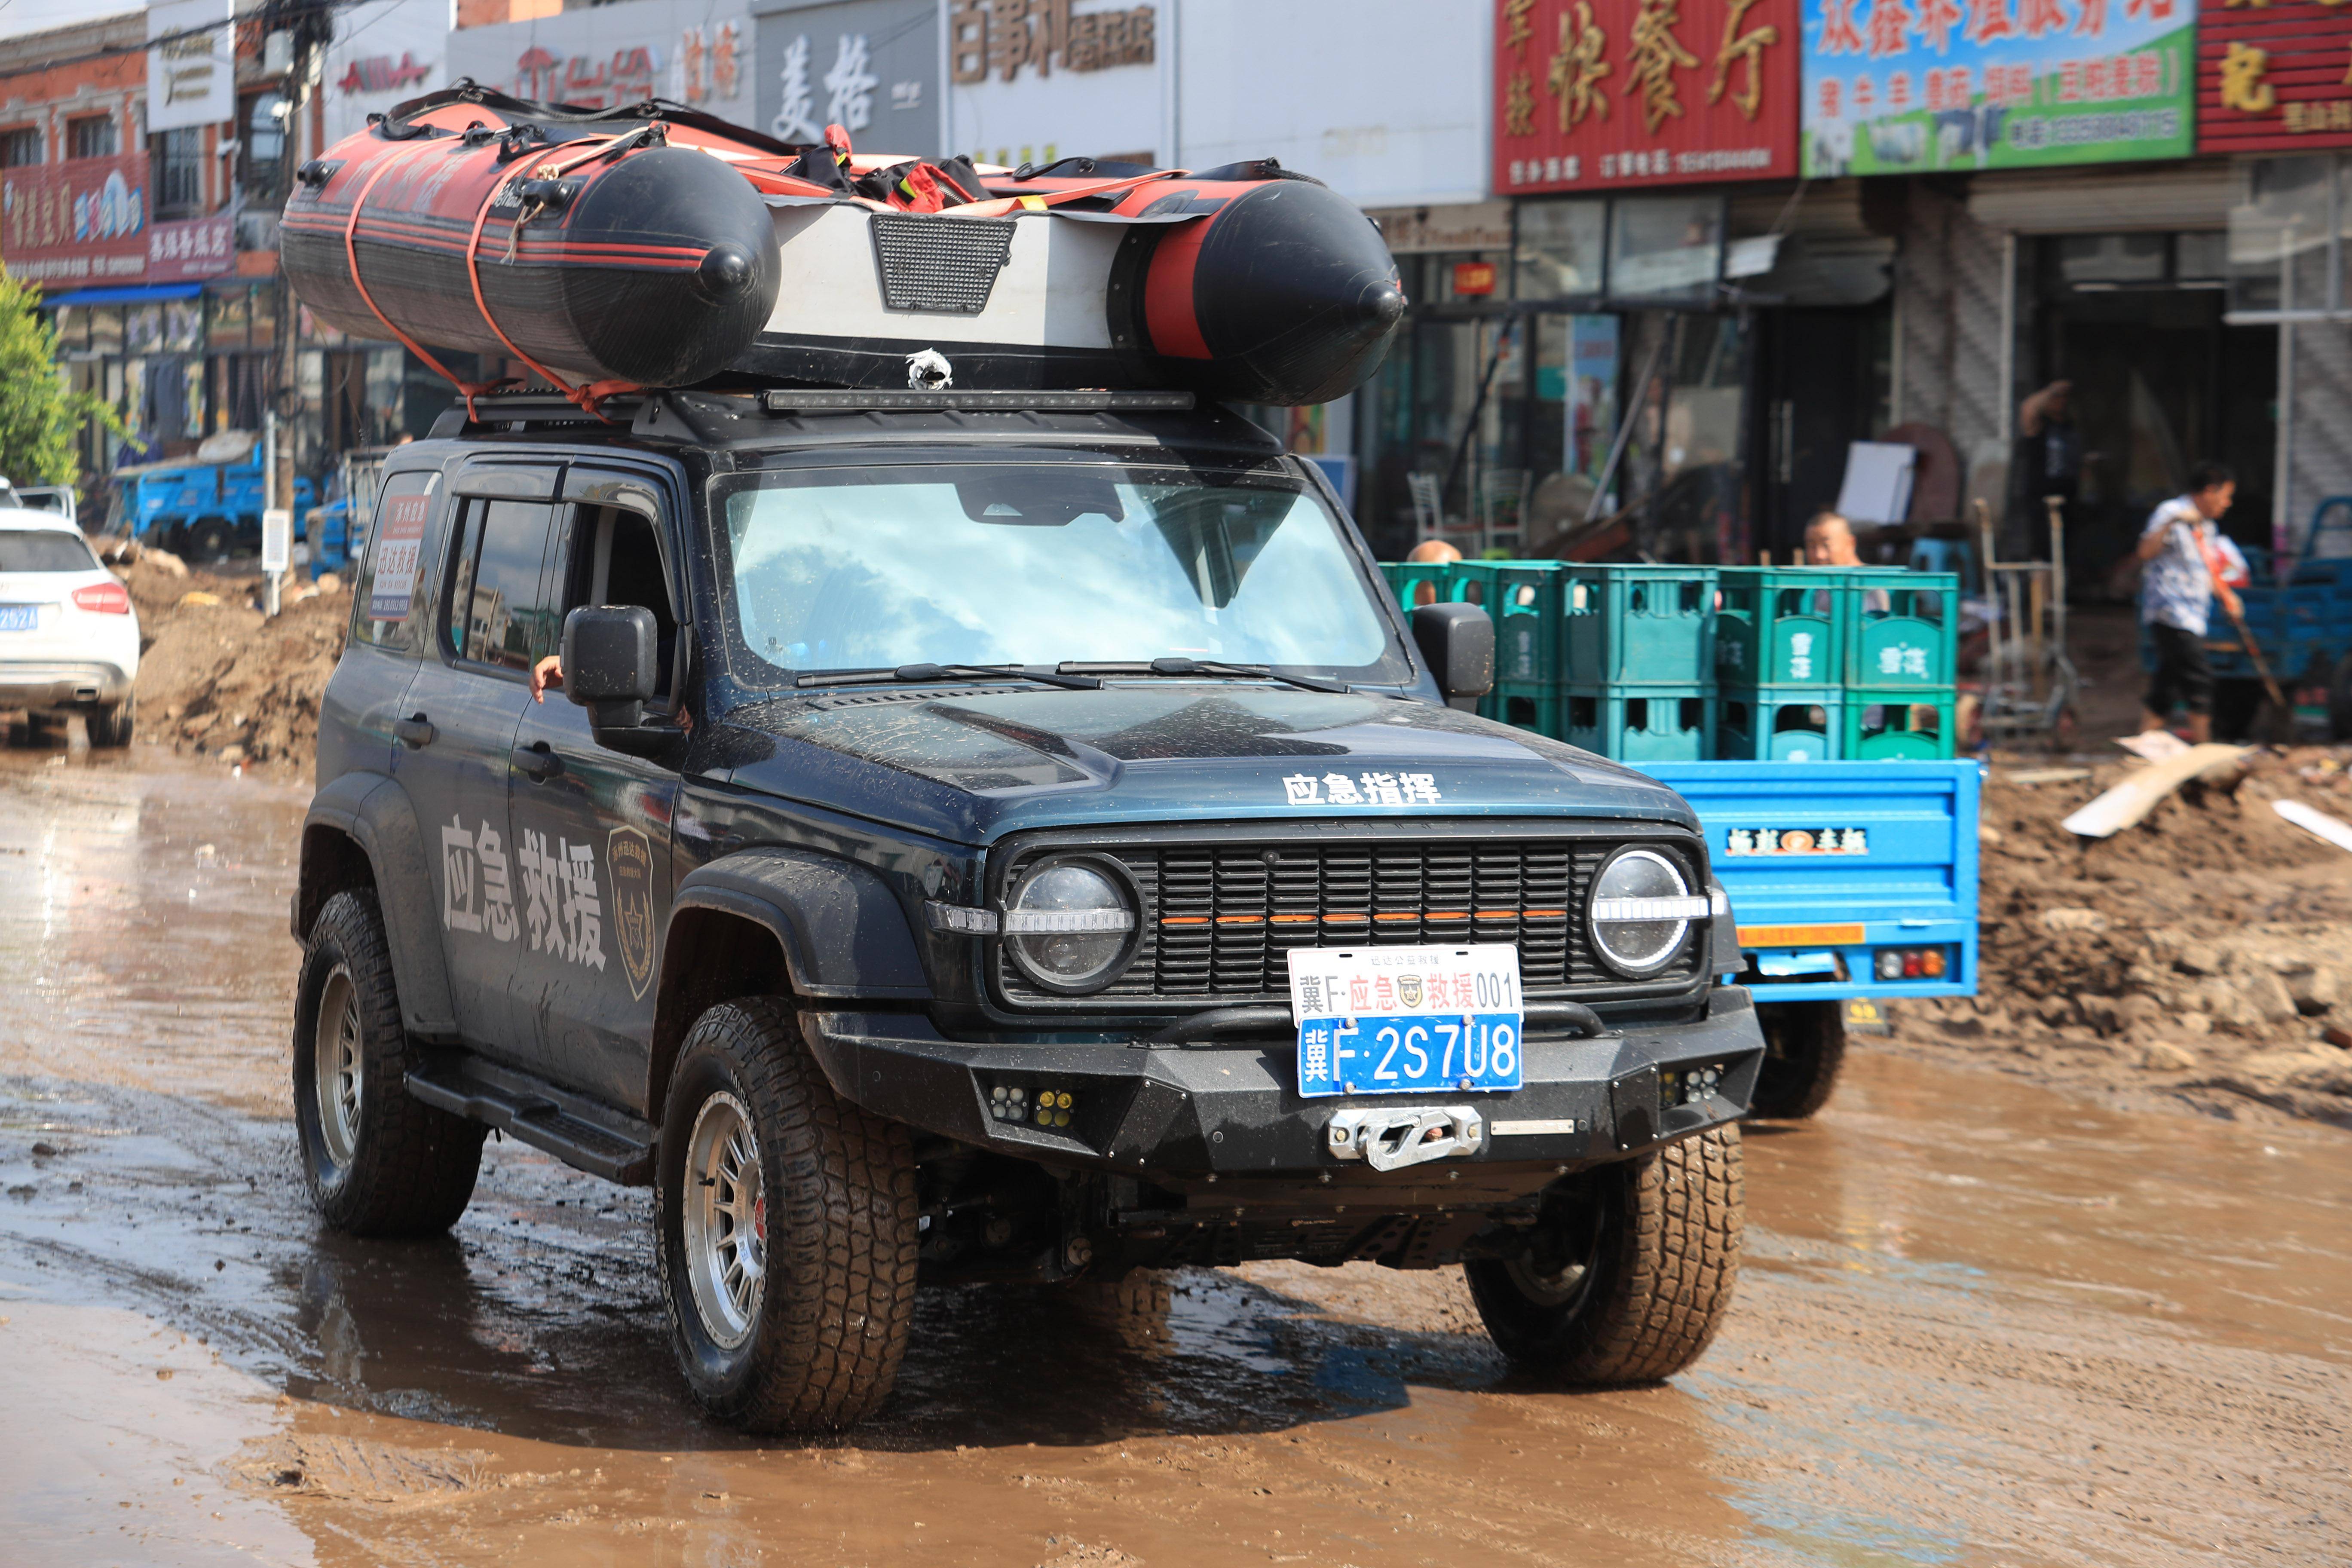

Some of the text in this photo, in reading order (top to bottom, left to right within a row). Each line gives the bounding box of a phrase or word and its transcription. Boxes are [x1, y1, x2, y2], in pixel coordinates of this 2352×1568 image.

[378, 545, 417, 575] 迅达救援
[1282, 772, 1442, 806] 应急指挥
[441, 813, 606, 972] 应急救援
[1371, 954, 1440, 966] 迅达公益救援
